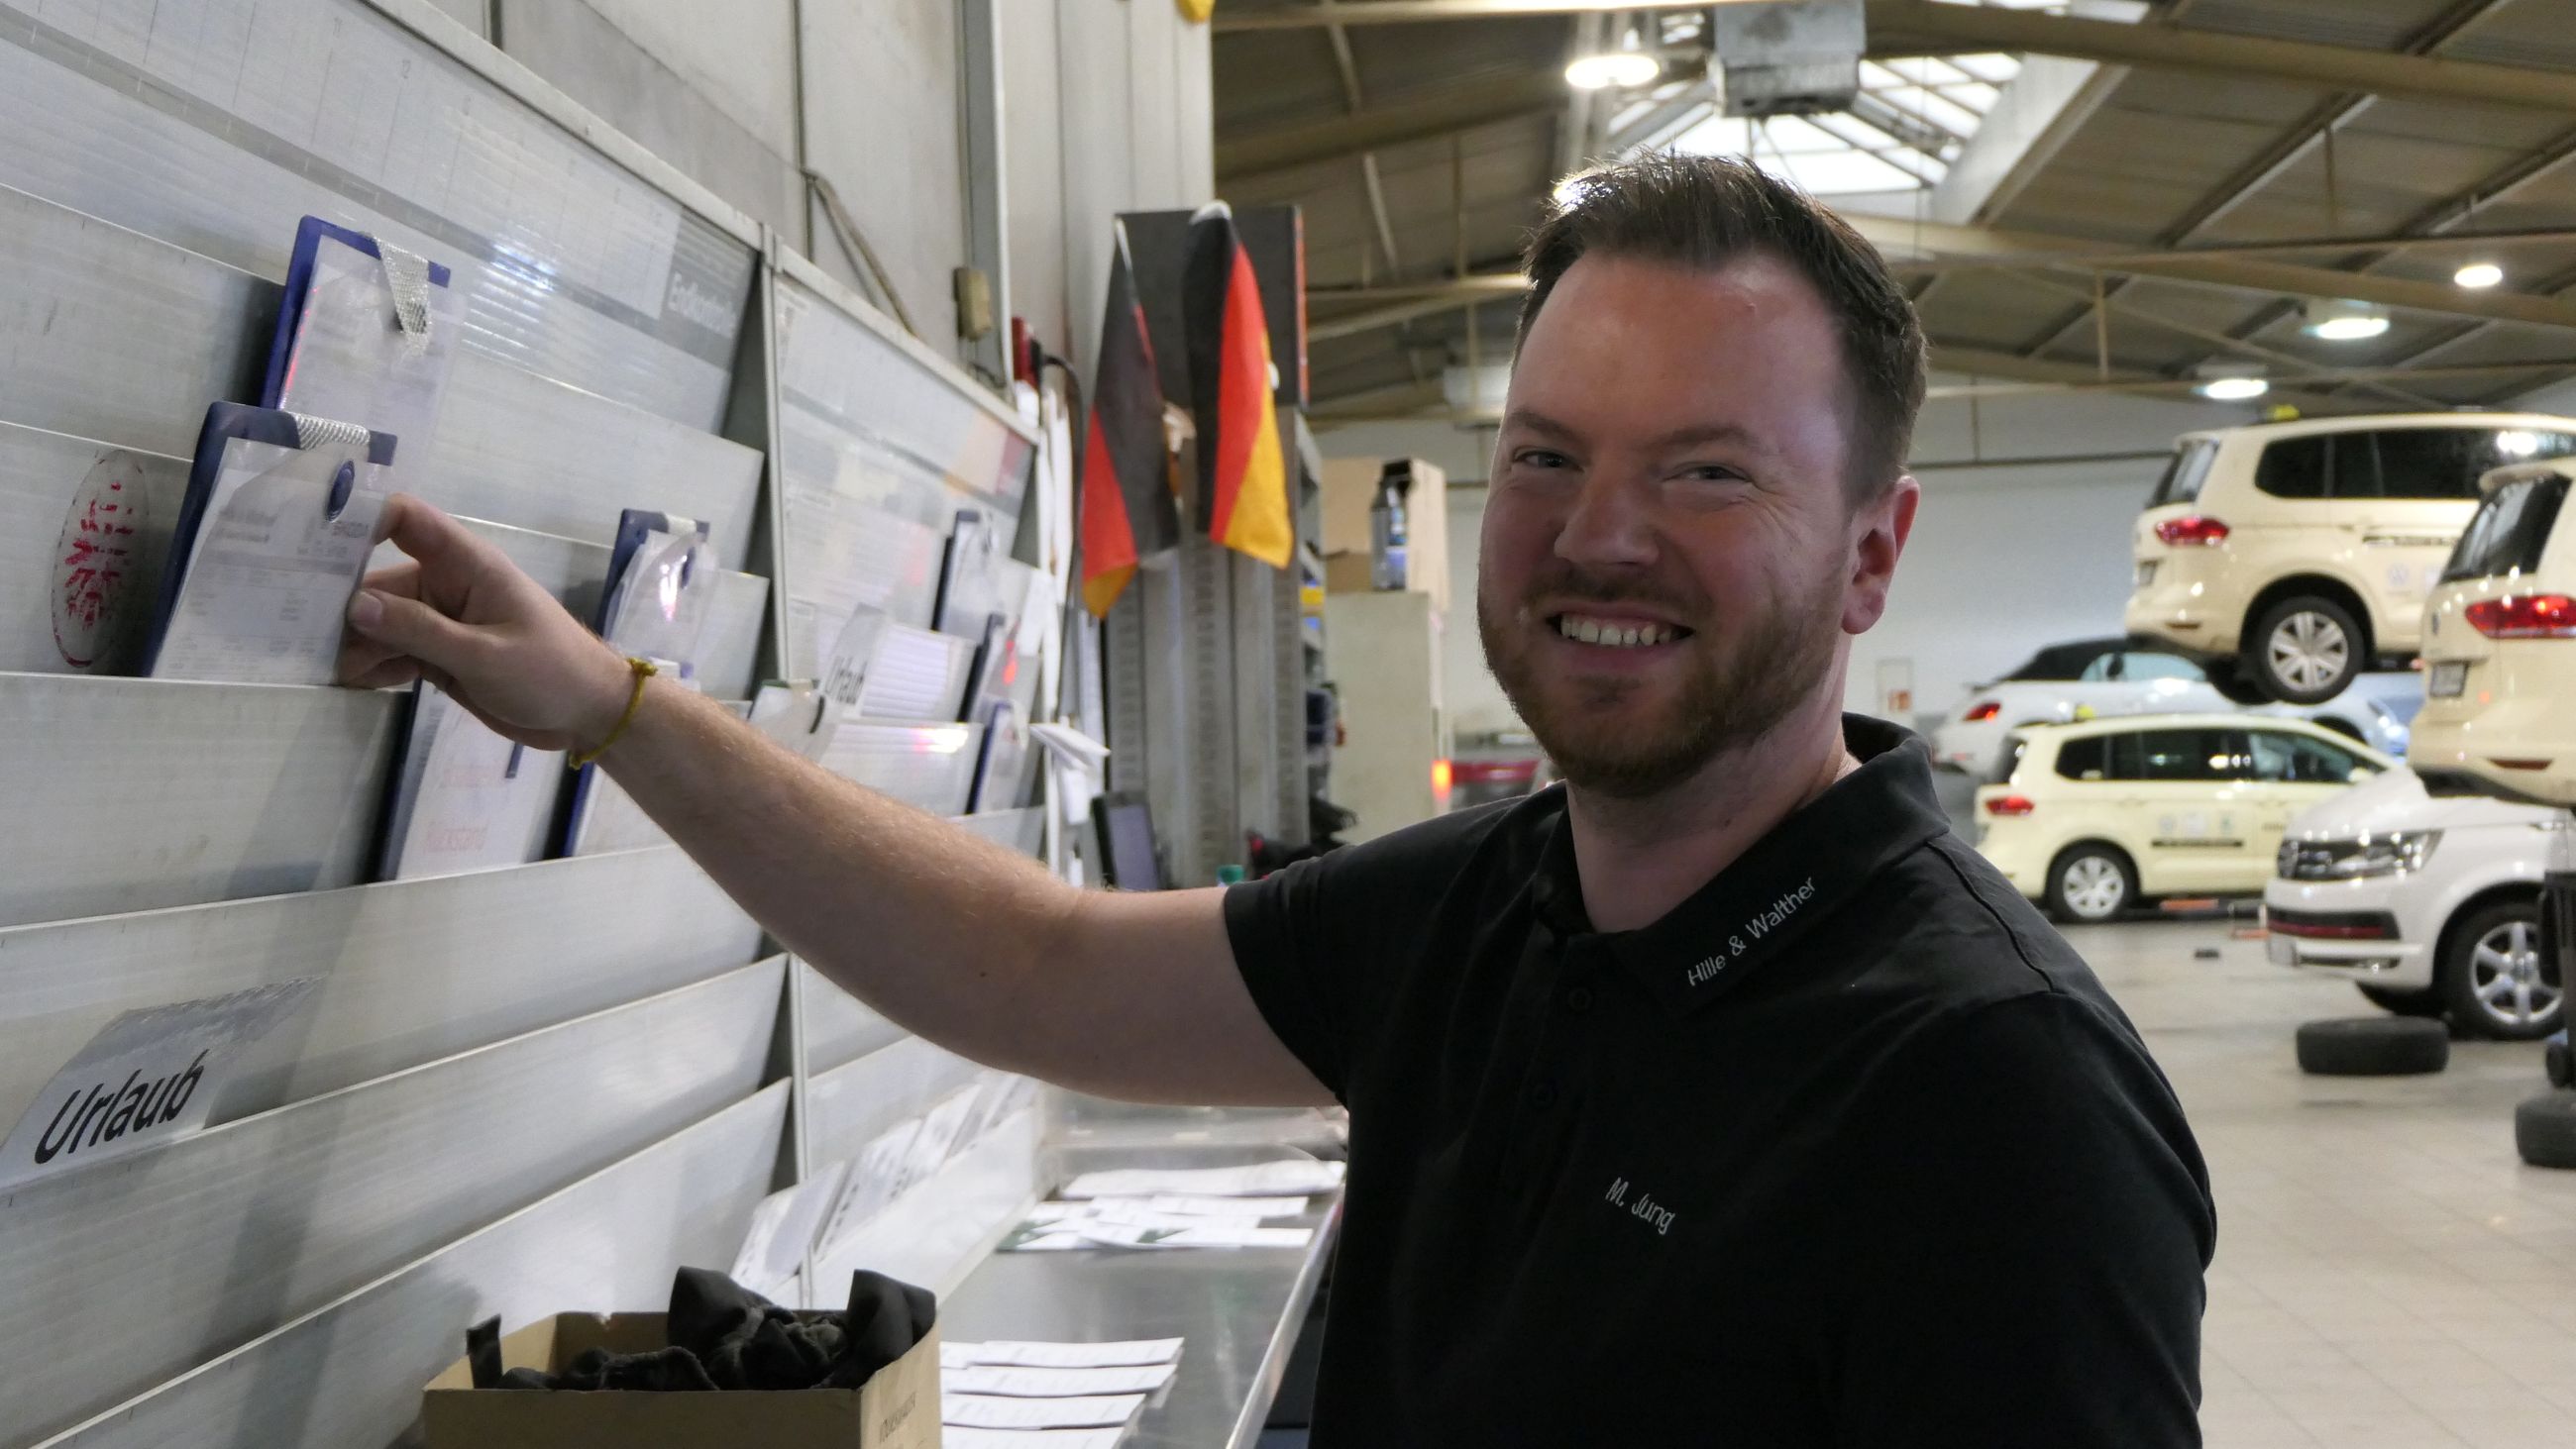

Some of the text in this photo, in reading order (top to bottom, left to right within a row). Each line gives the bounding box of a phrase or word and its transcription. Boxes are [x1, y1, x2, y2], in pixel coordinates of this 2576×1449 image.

[1728, 935, 1747, 957] &
[1745, 877, 1815, 940] Walther
[34, 1048, 209, 1165] Urlaub
[1605, 1177, 1676, 1236] M. Jung
